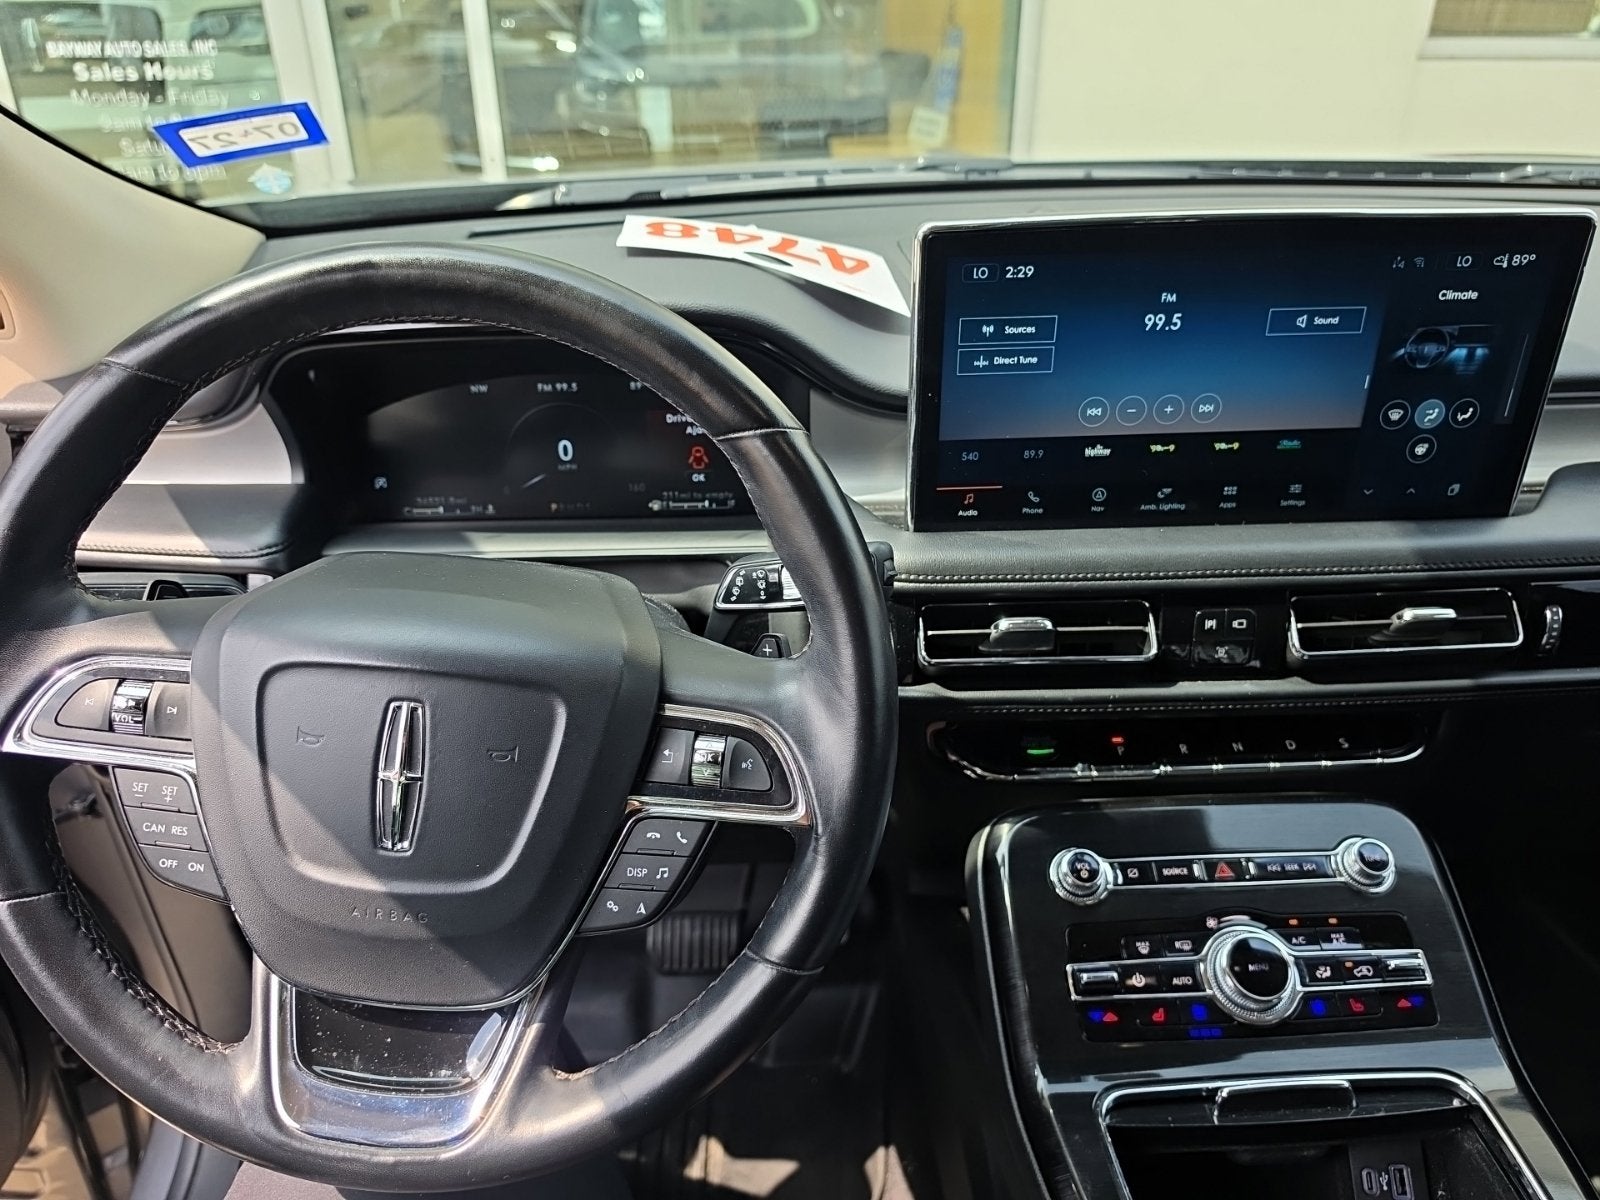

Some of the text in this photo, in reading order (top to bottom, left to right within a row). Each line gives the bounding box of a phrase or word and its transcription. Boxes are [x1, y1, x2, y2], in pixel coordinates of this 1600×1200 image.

[45, 40, 102, 58] BAYWAY
[104, 40, 142, 58] AUTO
[73, 62, 214, 82] Sales Hours
[70, 89, 150, 108] Monday
[167, 87, 230, 107] Friday
[643, 220, 871, 276] 4748
[1456, 255, 1473, 268] LO
[973, 265, 1034, 279] LO 2:29
[1161, 292, 1177, 303] FM
[1439, 289, 1479, 301] Climate
[1144, 313, 1183, 331] 99.5
[1313, 315, 1340, 325] Sound
[1004, 324, 1036, 335] Sources
[993, 354, 1038, 366] Direct Tune
[469, 384, 489, 394] NW
[536, 382, 578, 393] FM 99.5
[557, 439, 574, 462] 0
[1023, 450, 1044, 460] 89.9
[961, 452, 979, 462] 540
[691, 473, 706, 482] OK
[1140, 502, 1186, 513] Amb. Lighting
[1219, 501, 1236, 510] Apps
[1280, 498, 1306, 508] Settings
[958, 509, 978, 517] Audio
[1022, 507, 1043, 515] Phone
[1091, 505, 1105, 513] Nav
[133, 782, 149, 793] SET
[162, 785, 178, 796] SET
[143, 822, 166, 834] CAN
[171, 825, 188, 836] RES
[159, 858, 179, 869] OFF
[188, 862, 204, 872] ON
[1074, 862, 1091, 870] VOL
[627, 867, 648, 878] DISP
[1162, 868, 1189, 876] SOURCE
[351, 906, 429, 924] AIRBAG
[1291, 936, 1307, 945] A/C
[1248, 962, 1269, 972] MENU
[1172, 976, 1193, 986] AUTO
